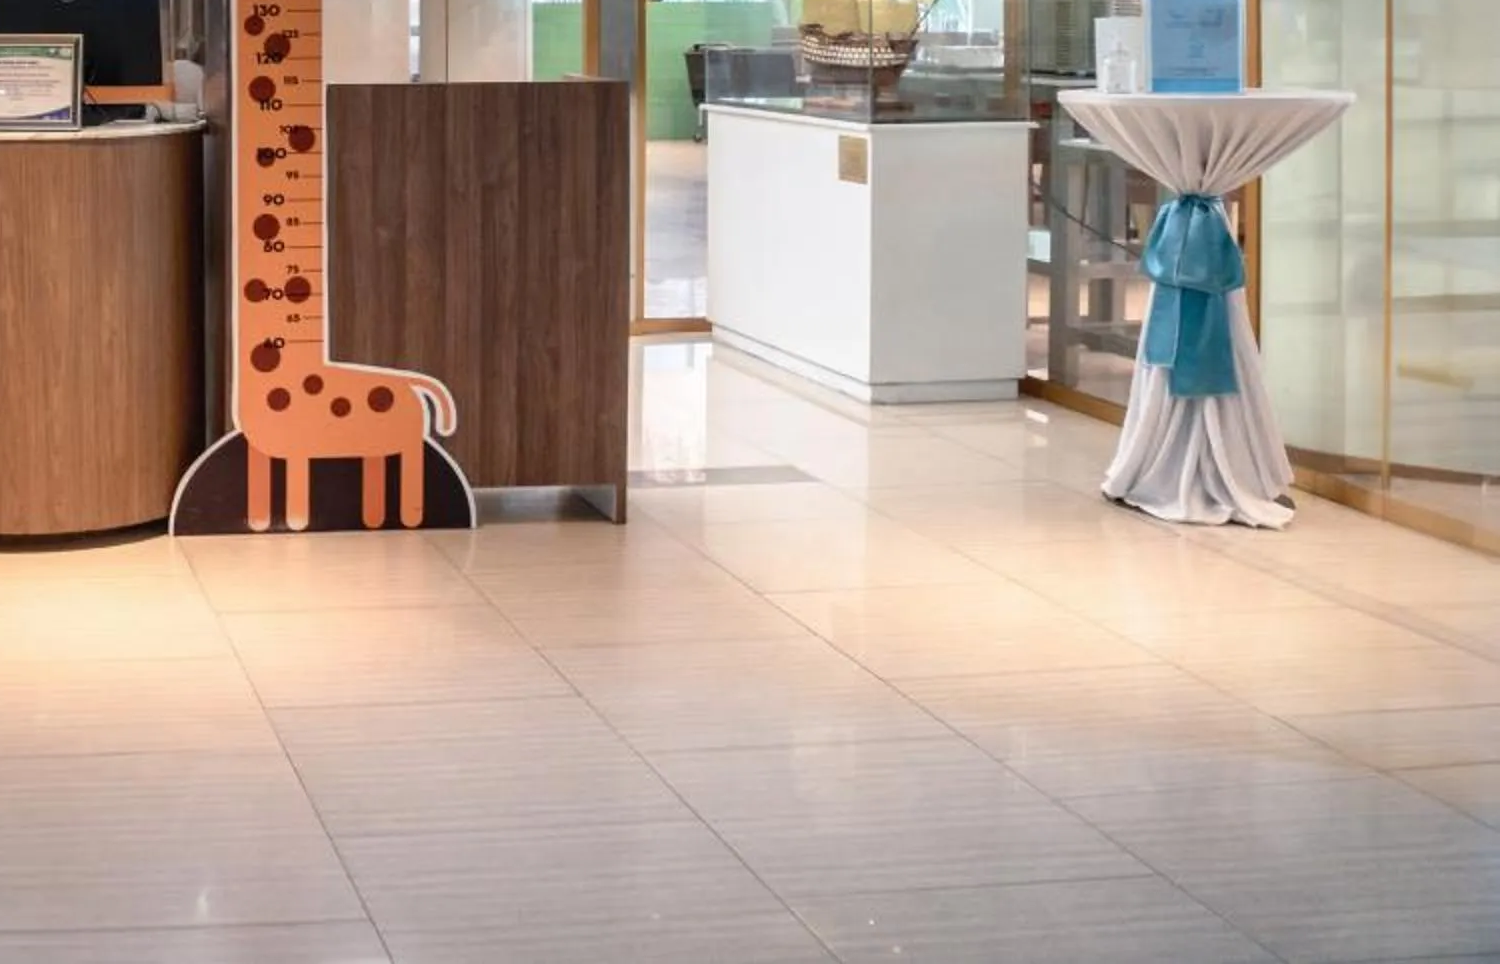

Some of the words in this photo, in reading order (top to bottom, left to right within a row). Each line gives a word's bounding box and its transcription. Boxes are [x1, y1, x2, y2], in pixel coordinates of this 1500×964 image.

[253, 4, 281, 17] 130
[256, 51, 282, 64] 120
[259, 99, 283, 111] 110
[286, 169, 299, 180] 95
[263, 193, 285, 206] 90
[263, 240, 285, 253] 80
[286, 263, 300, 274] 75
[262, 288, 284, 301] 70
[286, 313, 301, 324] 65
